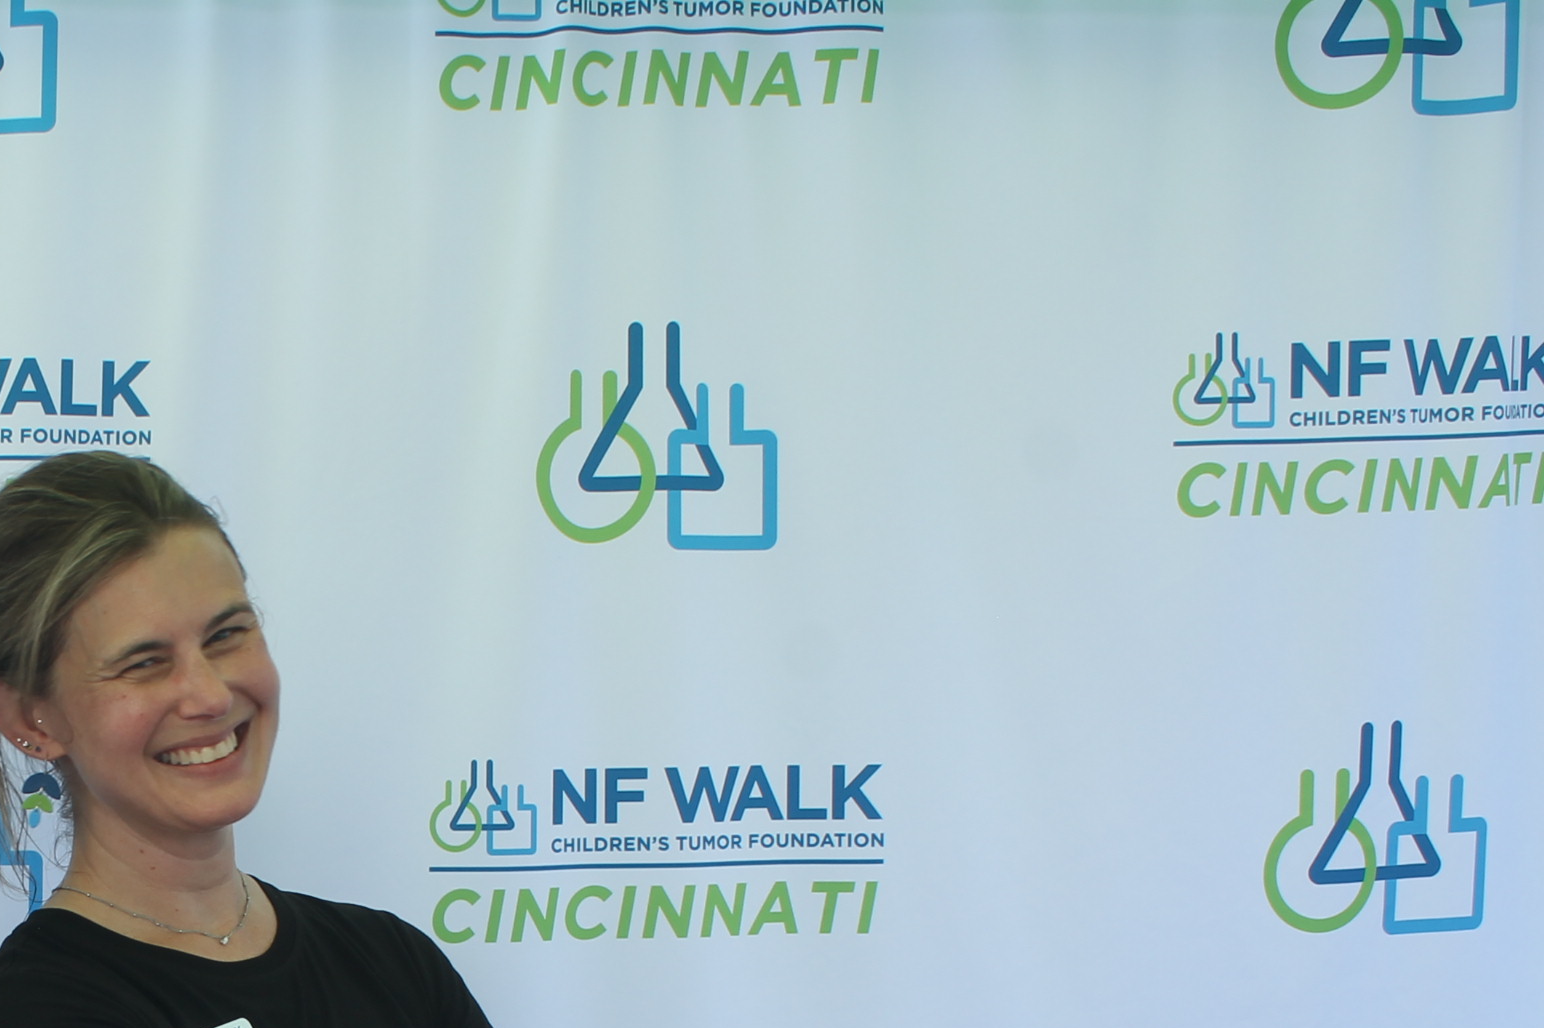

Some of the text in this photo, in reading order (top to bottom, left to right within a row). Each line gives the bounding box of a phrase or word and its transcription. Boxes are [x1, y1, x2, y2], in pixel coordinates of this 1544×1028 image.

[556, 0, 885, 18] CHILDREN'S TUMOR FOUNDATION
[439, 48, 881, 111] CINCINNATI
[1289, 339, 1392, 399] NF
[19, 428, 153, 446] FOUNDATION
[1289, 408, 1406, 427] CHILDREN'S
[1410, 406, 1475, 424] TUMOR
[552, 763, 883, 825] NF WALK
[550, 832, 885, 854] CHILDREN'S TUMOR FOUNDATION
[431, 881, 878, 944] CINCINNATI
